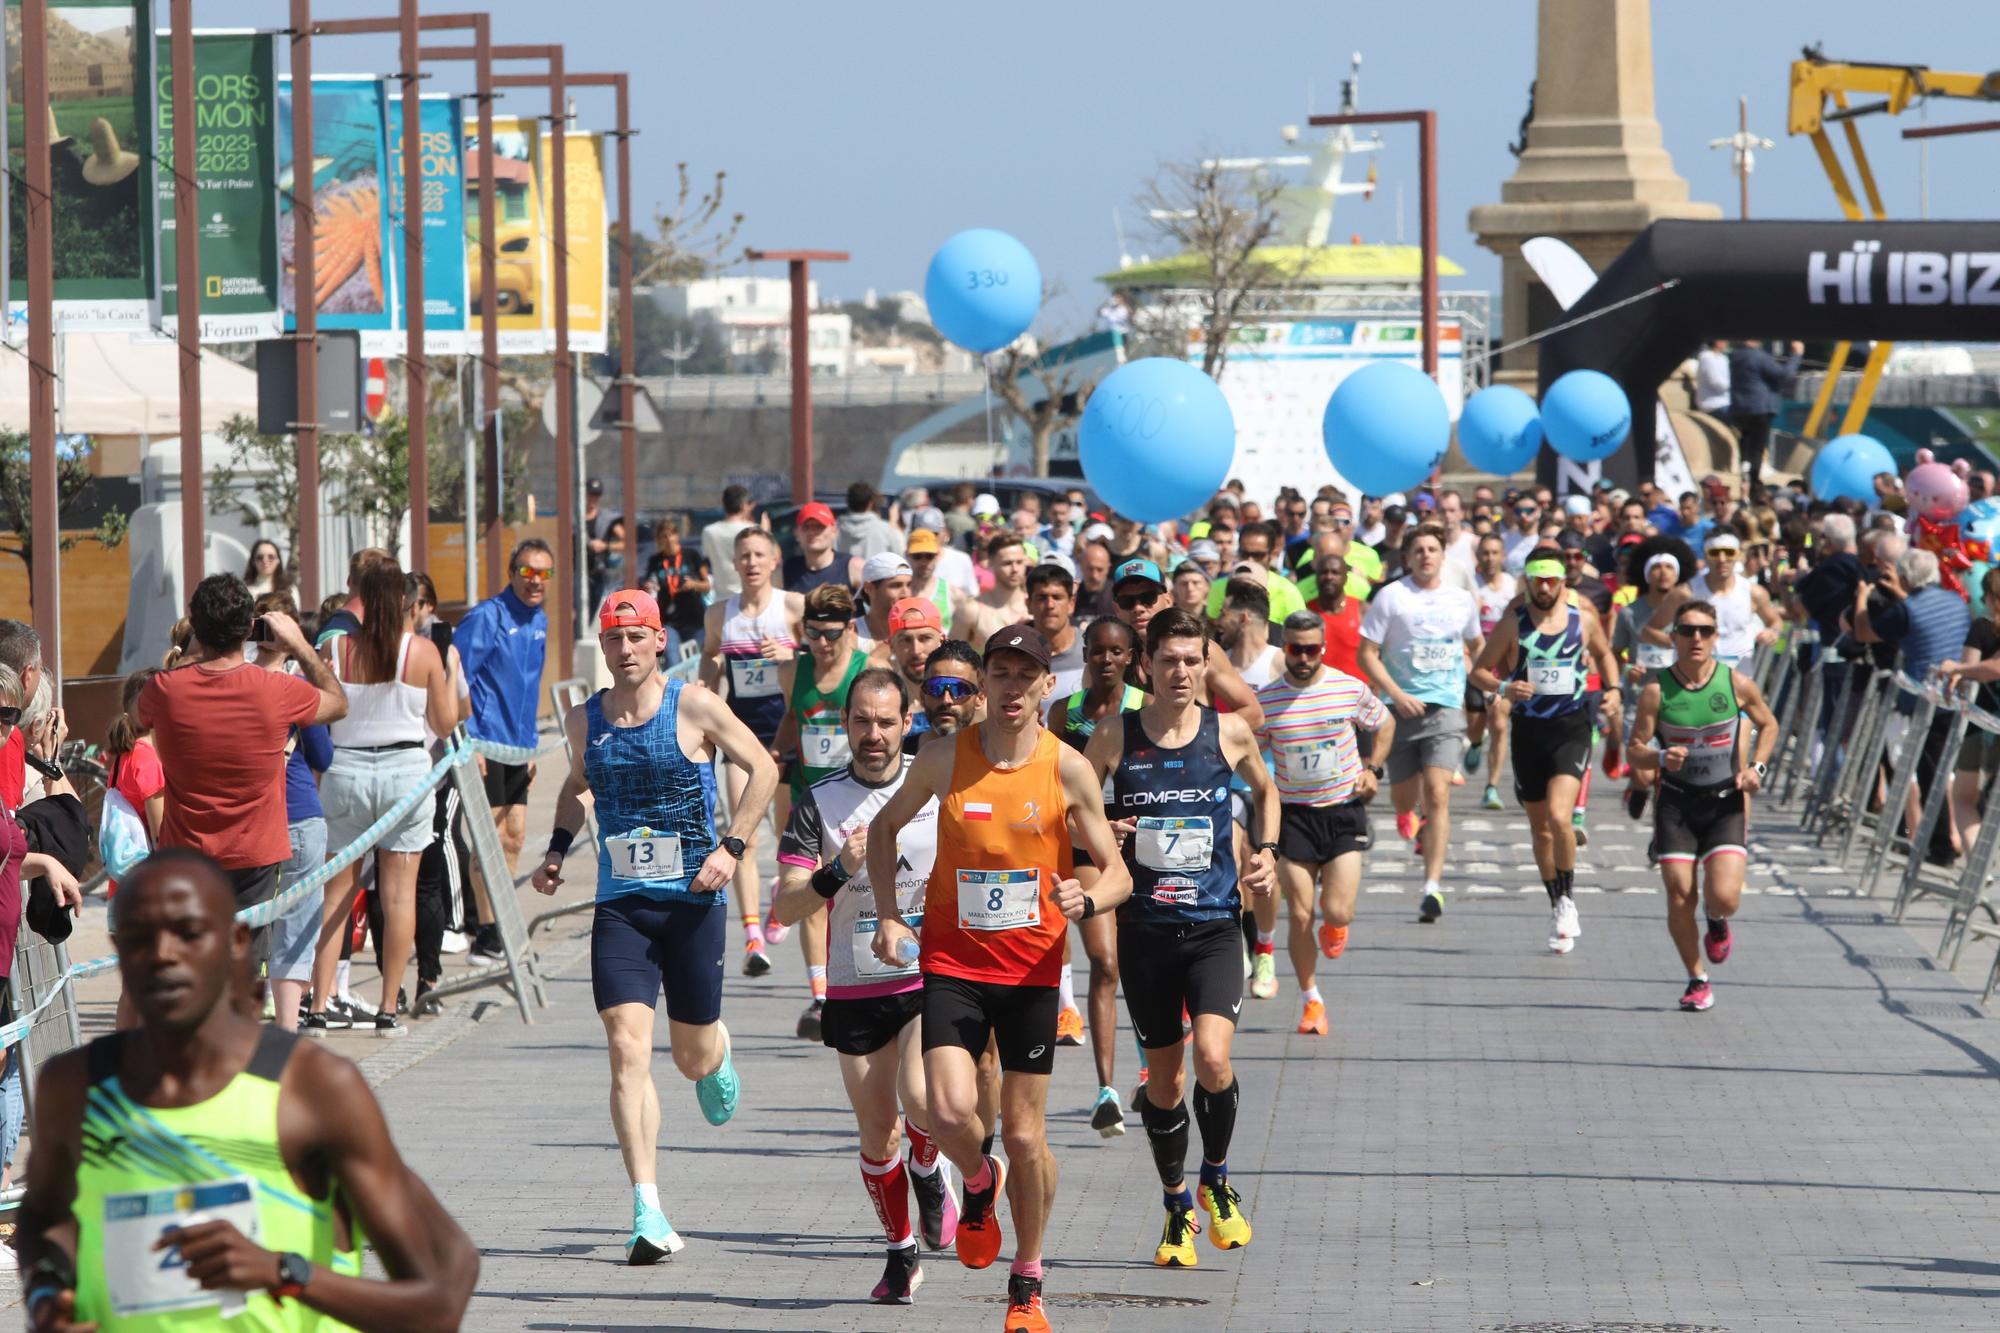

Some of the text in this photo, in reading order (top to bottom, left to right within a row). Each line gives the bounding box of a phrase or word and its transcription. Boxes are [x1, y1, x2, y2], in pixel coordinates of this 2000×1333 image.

[745, 670, 764, 685] 24
[1540, 670, 1559, 684] 29
[820, 738, 831, 754] 9
[1300, 753, 1320, 770] 17
[1122, 788, 1213, 807] COMPEX
[627, 842, 654, 863] 13
[1164, 833, 1180, 854] 7
[987, 888, 1004, 911] 8
